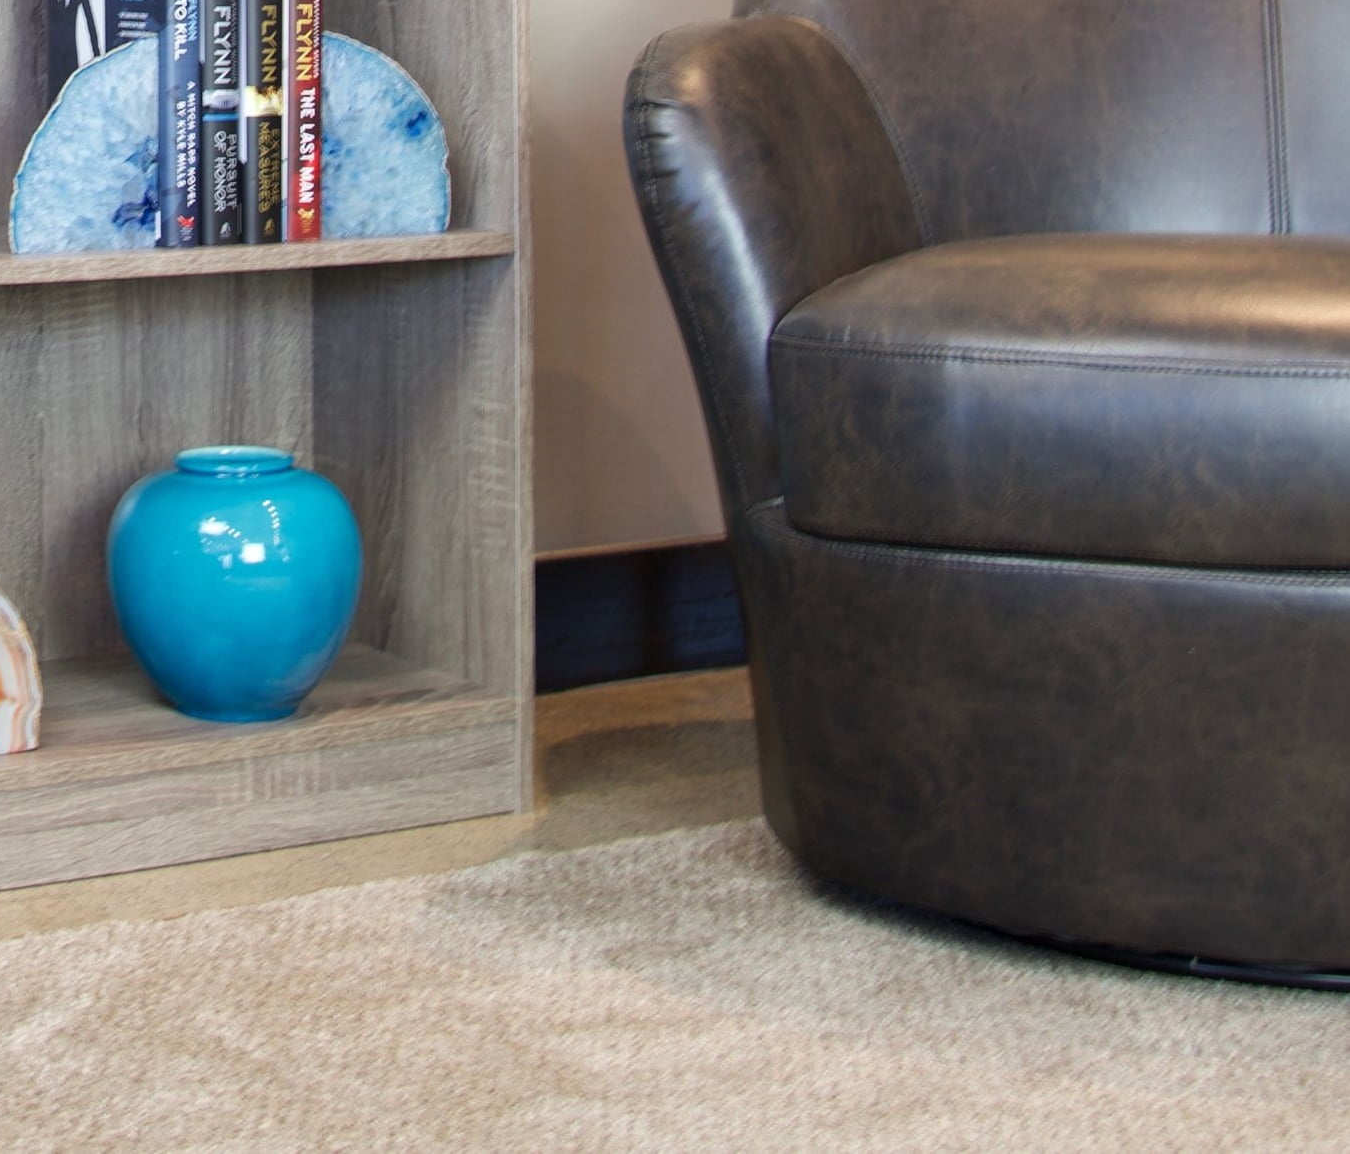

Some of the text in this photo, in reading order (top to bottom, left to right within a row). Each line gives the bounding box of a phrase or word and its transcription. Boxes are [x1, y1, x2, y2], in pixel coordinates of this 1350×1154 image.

[174, 23, 188, 61] KILL
[213, 6, 231, 84] FLYNN
[260, 6, 277, 83] FLYNN
[295, 4, 314, 81] FLYNN
[300, 87, 316, 119] THE
[176, 100, 187, 188] BY KYLE MILLS
[186, 80, 197, 208] A MITCH RAPP NOVEL
[213, 130, 228, 213] OF HONOR
[226, 134, 238, 210] PURSUIT
[258, 122, 271, 213] MEASURES
[270, 128, 281, 207] EXTREME
[299, 123, 315, 162] LAST
[298, 167, 315, 204] MAN
